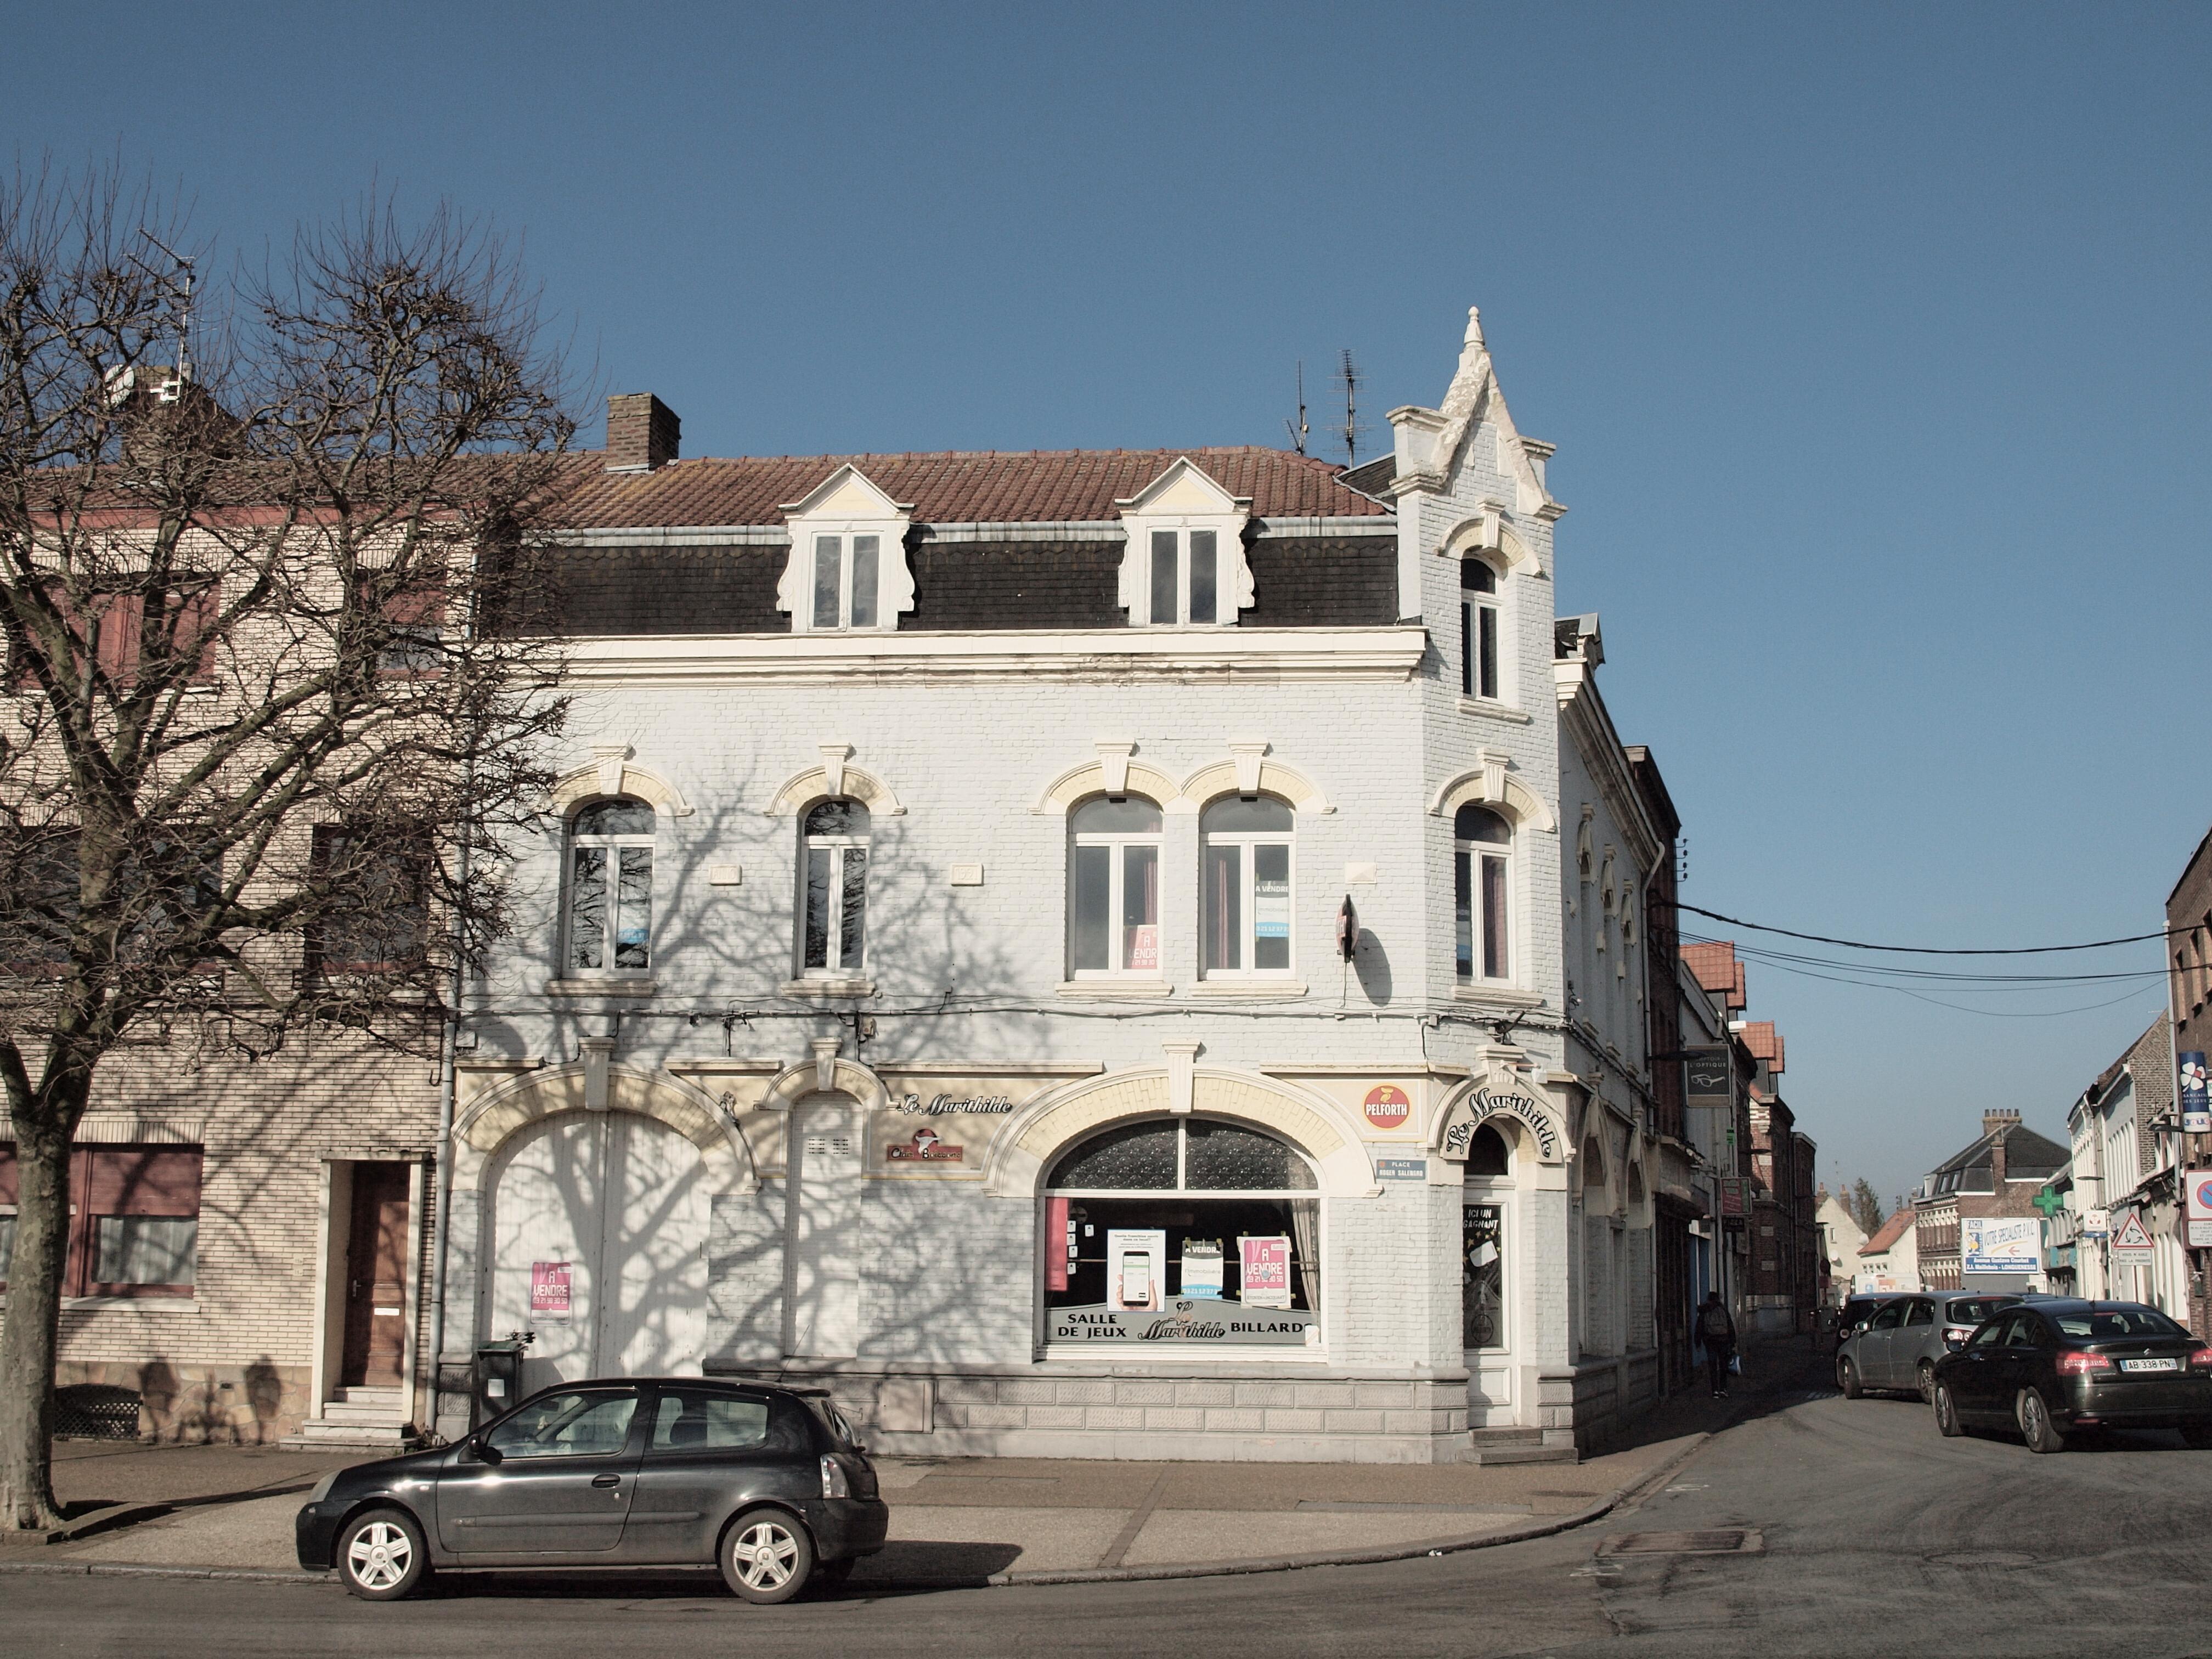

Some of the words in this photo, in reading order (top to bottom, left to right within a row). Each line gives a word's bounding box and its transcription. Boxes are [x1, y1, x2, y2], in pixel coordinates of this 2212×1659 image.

[1144, 935, 1150, 947] A
[896, 1093, 919, 1115] Le
[918, 1093, 1013, 1116] Marithilde
[1366, 1104, 1407, 1116] PELFORTH
[1447, 1123, 1469, 1154] Le
[1468, 1088, 1555, 1158] Marithilde
[1468, 1209, 1479, 1218] ICI
[1480, 1209, 1492, 1218] UN
[1463, 1220, 1498, 1229] GAGNANT
[1262, 1248, 1269, 1261] A
[1246, 1262, 1283, 1275] VENDRE
[549, 1271, 555, 1284] A
[534, 1284, 568, 1297] VENDRE
[1068, 1314, 1117, 1323] SALLE
[1058, 1327, 1079, 1336] DE
[1086, 1327, 1127, 1339] JEUX
[1138, 1319, 1225, 1340] Marithilde
[1231, 1323, 1312, 1333] BILLARD
[2129, 1360, 2170, 1369] AB-338-PN
